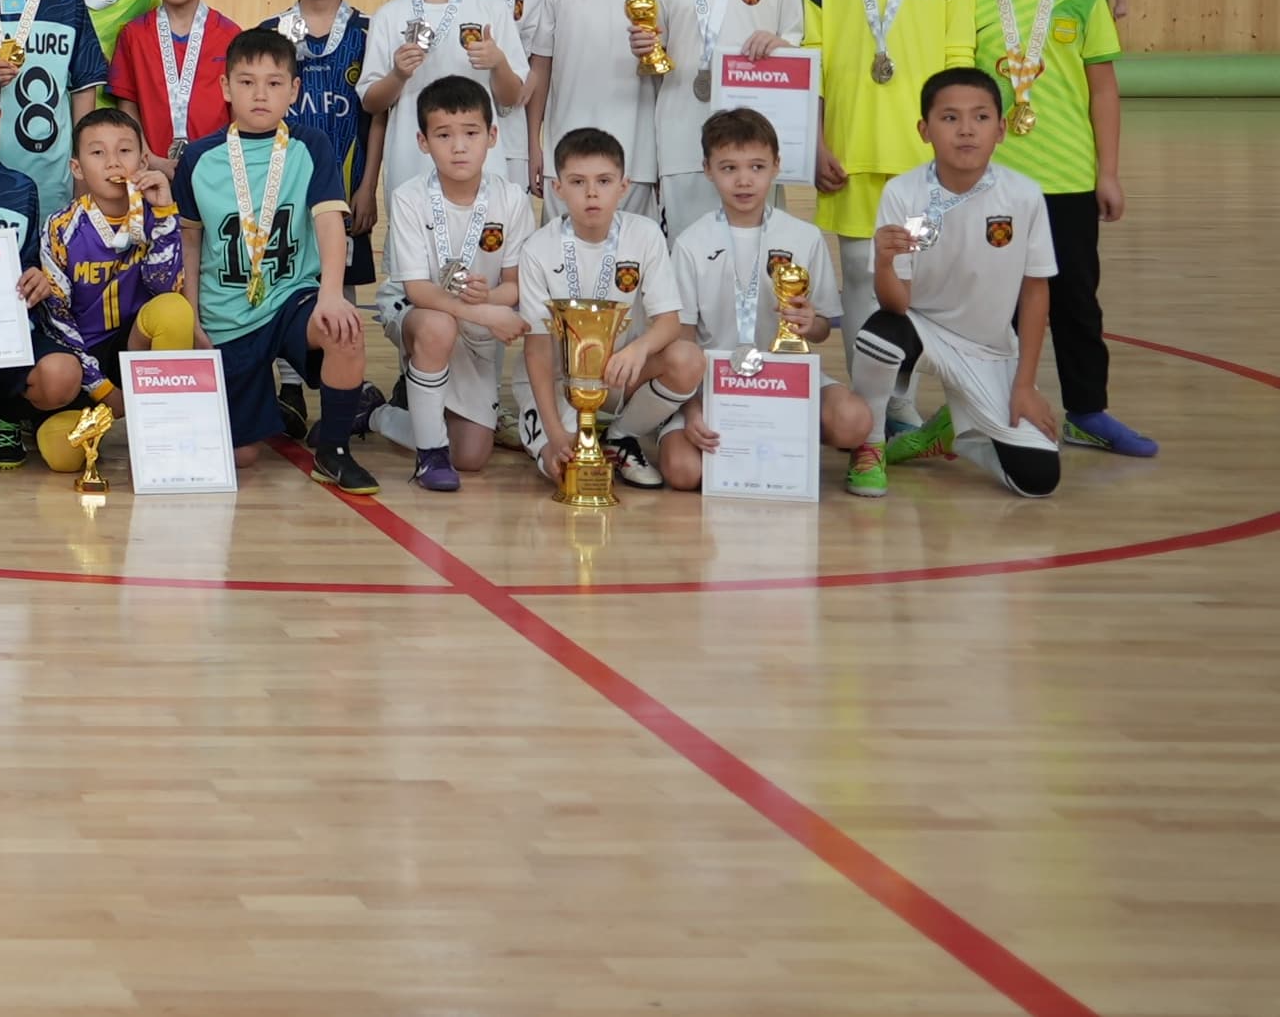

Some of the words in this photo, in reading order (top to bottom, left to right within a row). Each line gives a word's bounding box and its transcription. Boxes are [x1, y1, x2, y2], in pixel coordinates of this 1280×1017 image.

[159, 21, 177, 85] QAZAQSTAN
[179, 32, 201, 96] QAZAQSTAN
[726, 70, 790, 83] ГРАМОТА
[229, 140, 251, 214] QAZAQSTAN
[261, 155, 283, 228] QAZAQSTAN
[217, 204, 299, 288] 14
[137, 375, 197, 388] ГРАМОТА
[720, 377, 787, 391] ГРАМОТА
